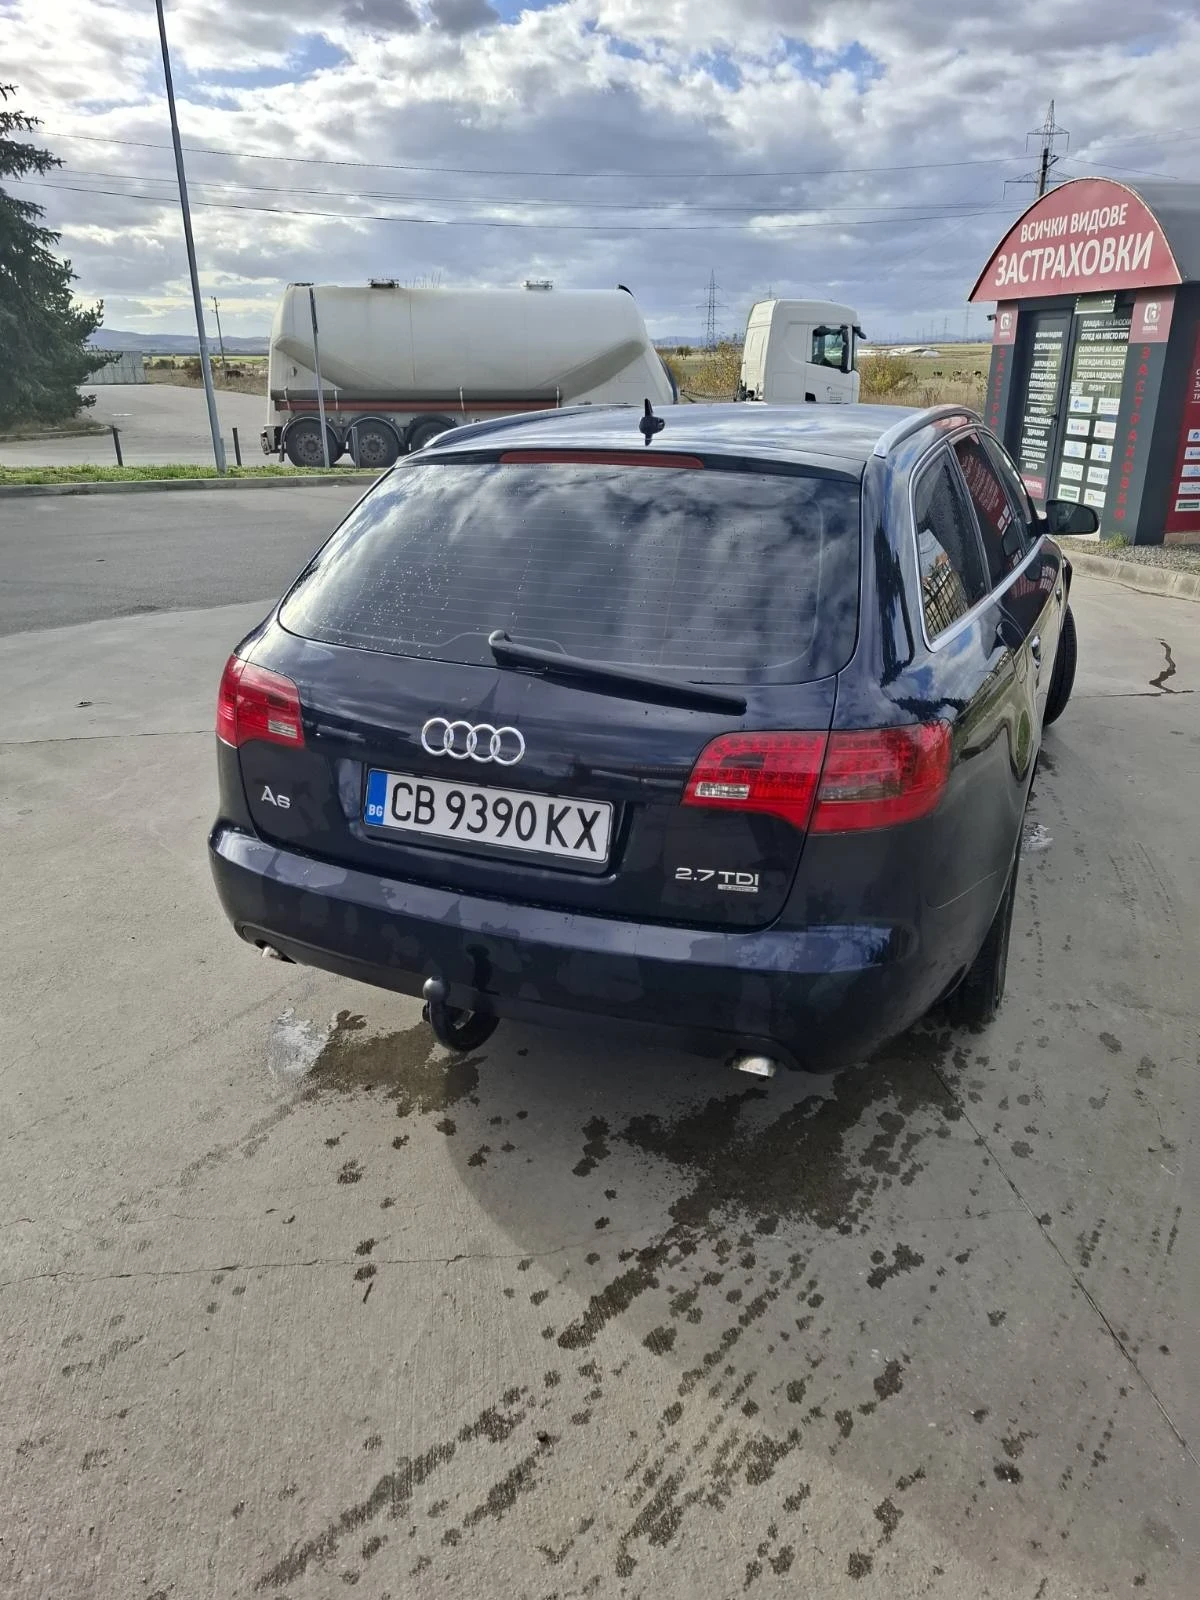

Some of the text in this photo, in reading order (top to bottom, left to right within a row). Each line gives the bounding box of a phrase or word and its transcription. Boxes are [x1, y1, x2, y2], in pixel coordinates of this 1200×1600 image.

[1020, 203, 1129, 243] ВСИЧКИ ВИДОВЕ
[995, 231, 1154, 287] ЗАСТРАХОВКИ
[260, 785, 291, 809] A6
[368, 804, 383, 817] BG
[391, 782, 600, 852] CB 9390 KX
[675, 867, 759, 886] 2.7 TDI
